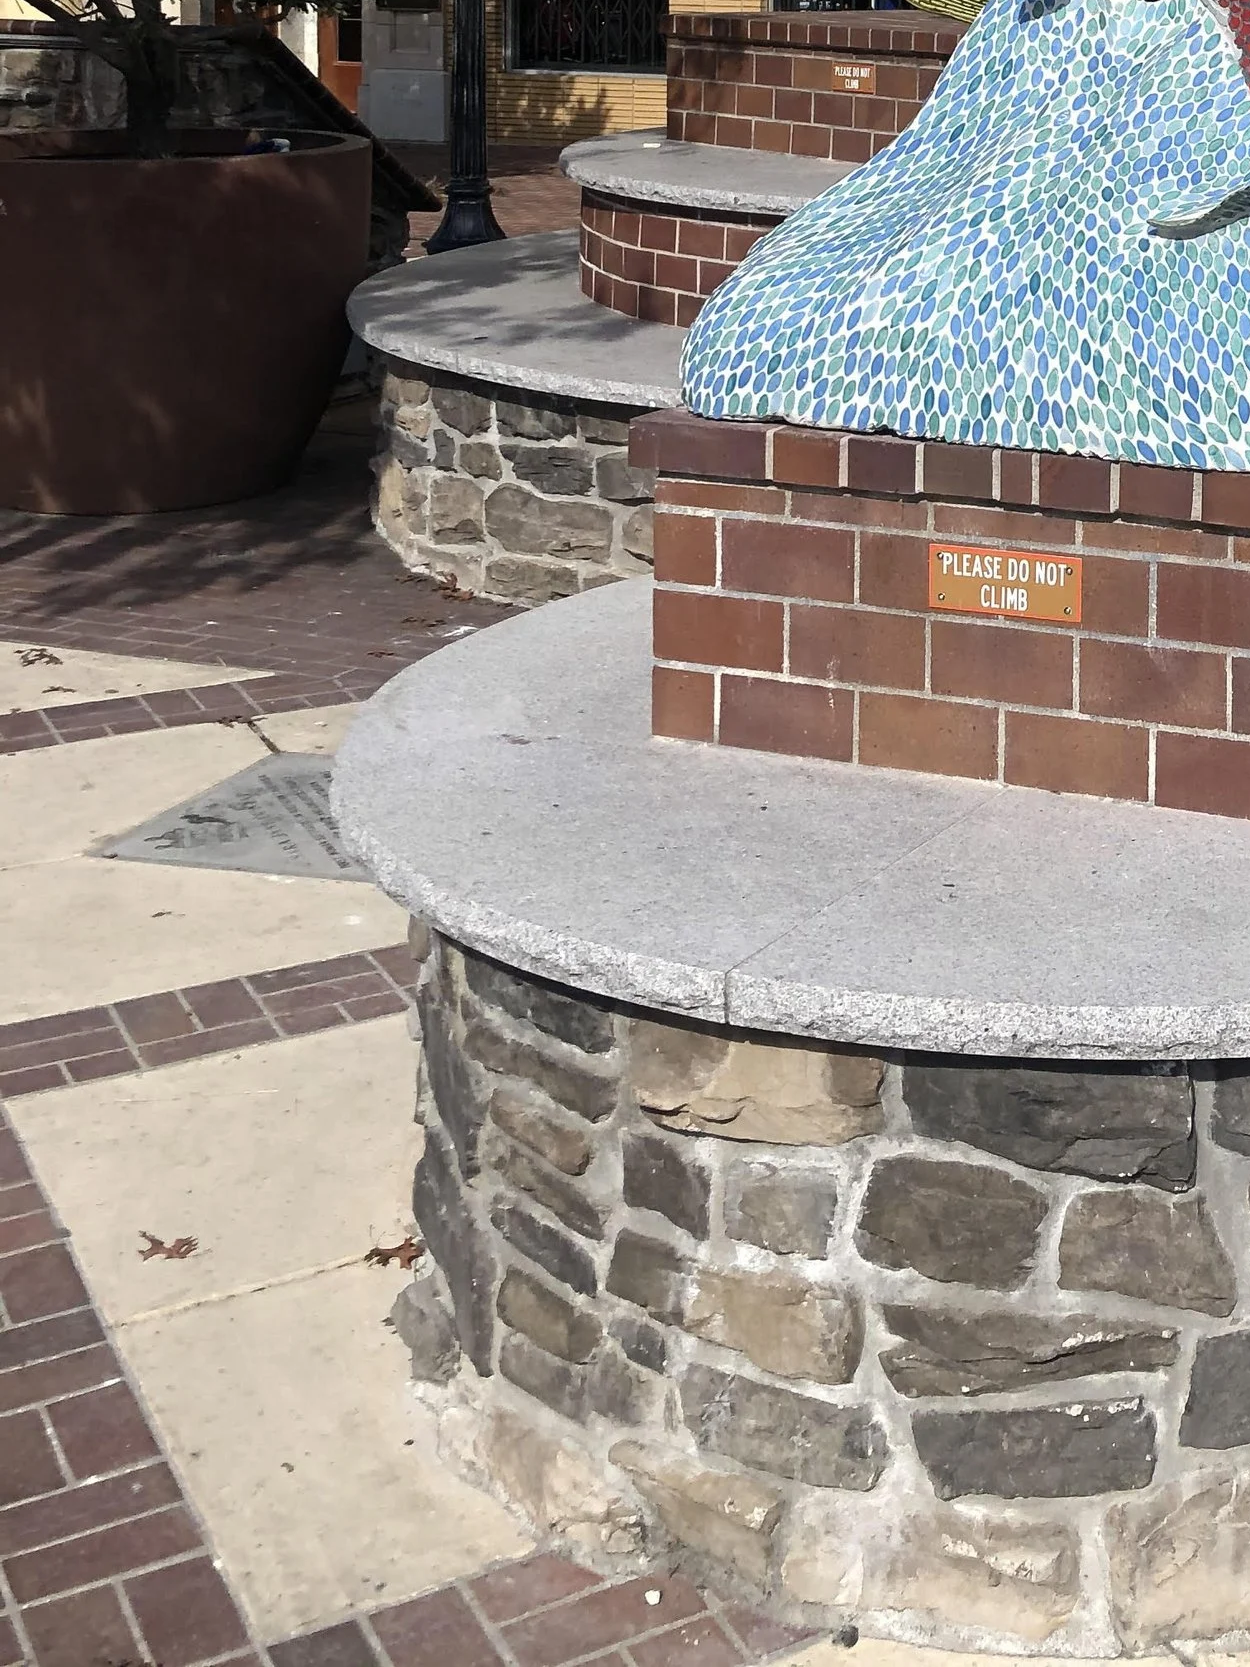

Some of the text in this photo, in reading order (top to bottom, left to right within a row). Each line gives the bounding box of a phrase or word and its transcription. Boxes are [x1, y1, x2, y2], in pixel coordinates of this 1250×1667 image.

[942, 551, 1067, 586] PLEASE DO NOT
[980, 584, 1028, 611] CLIMB
